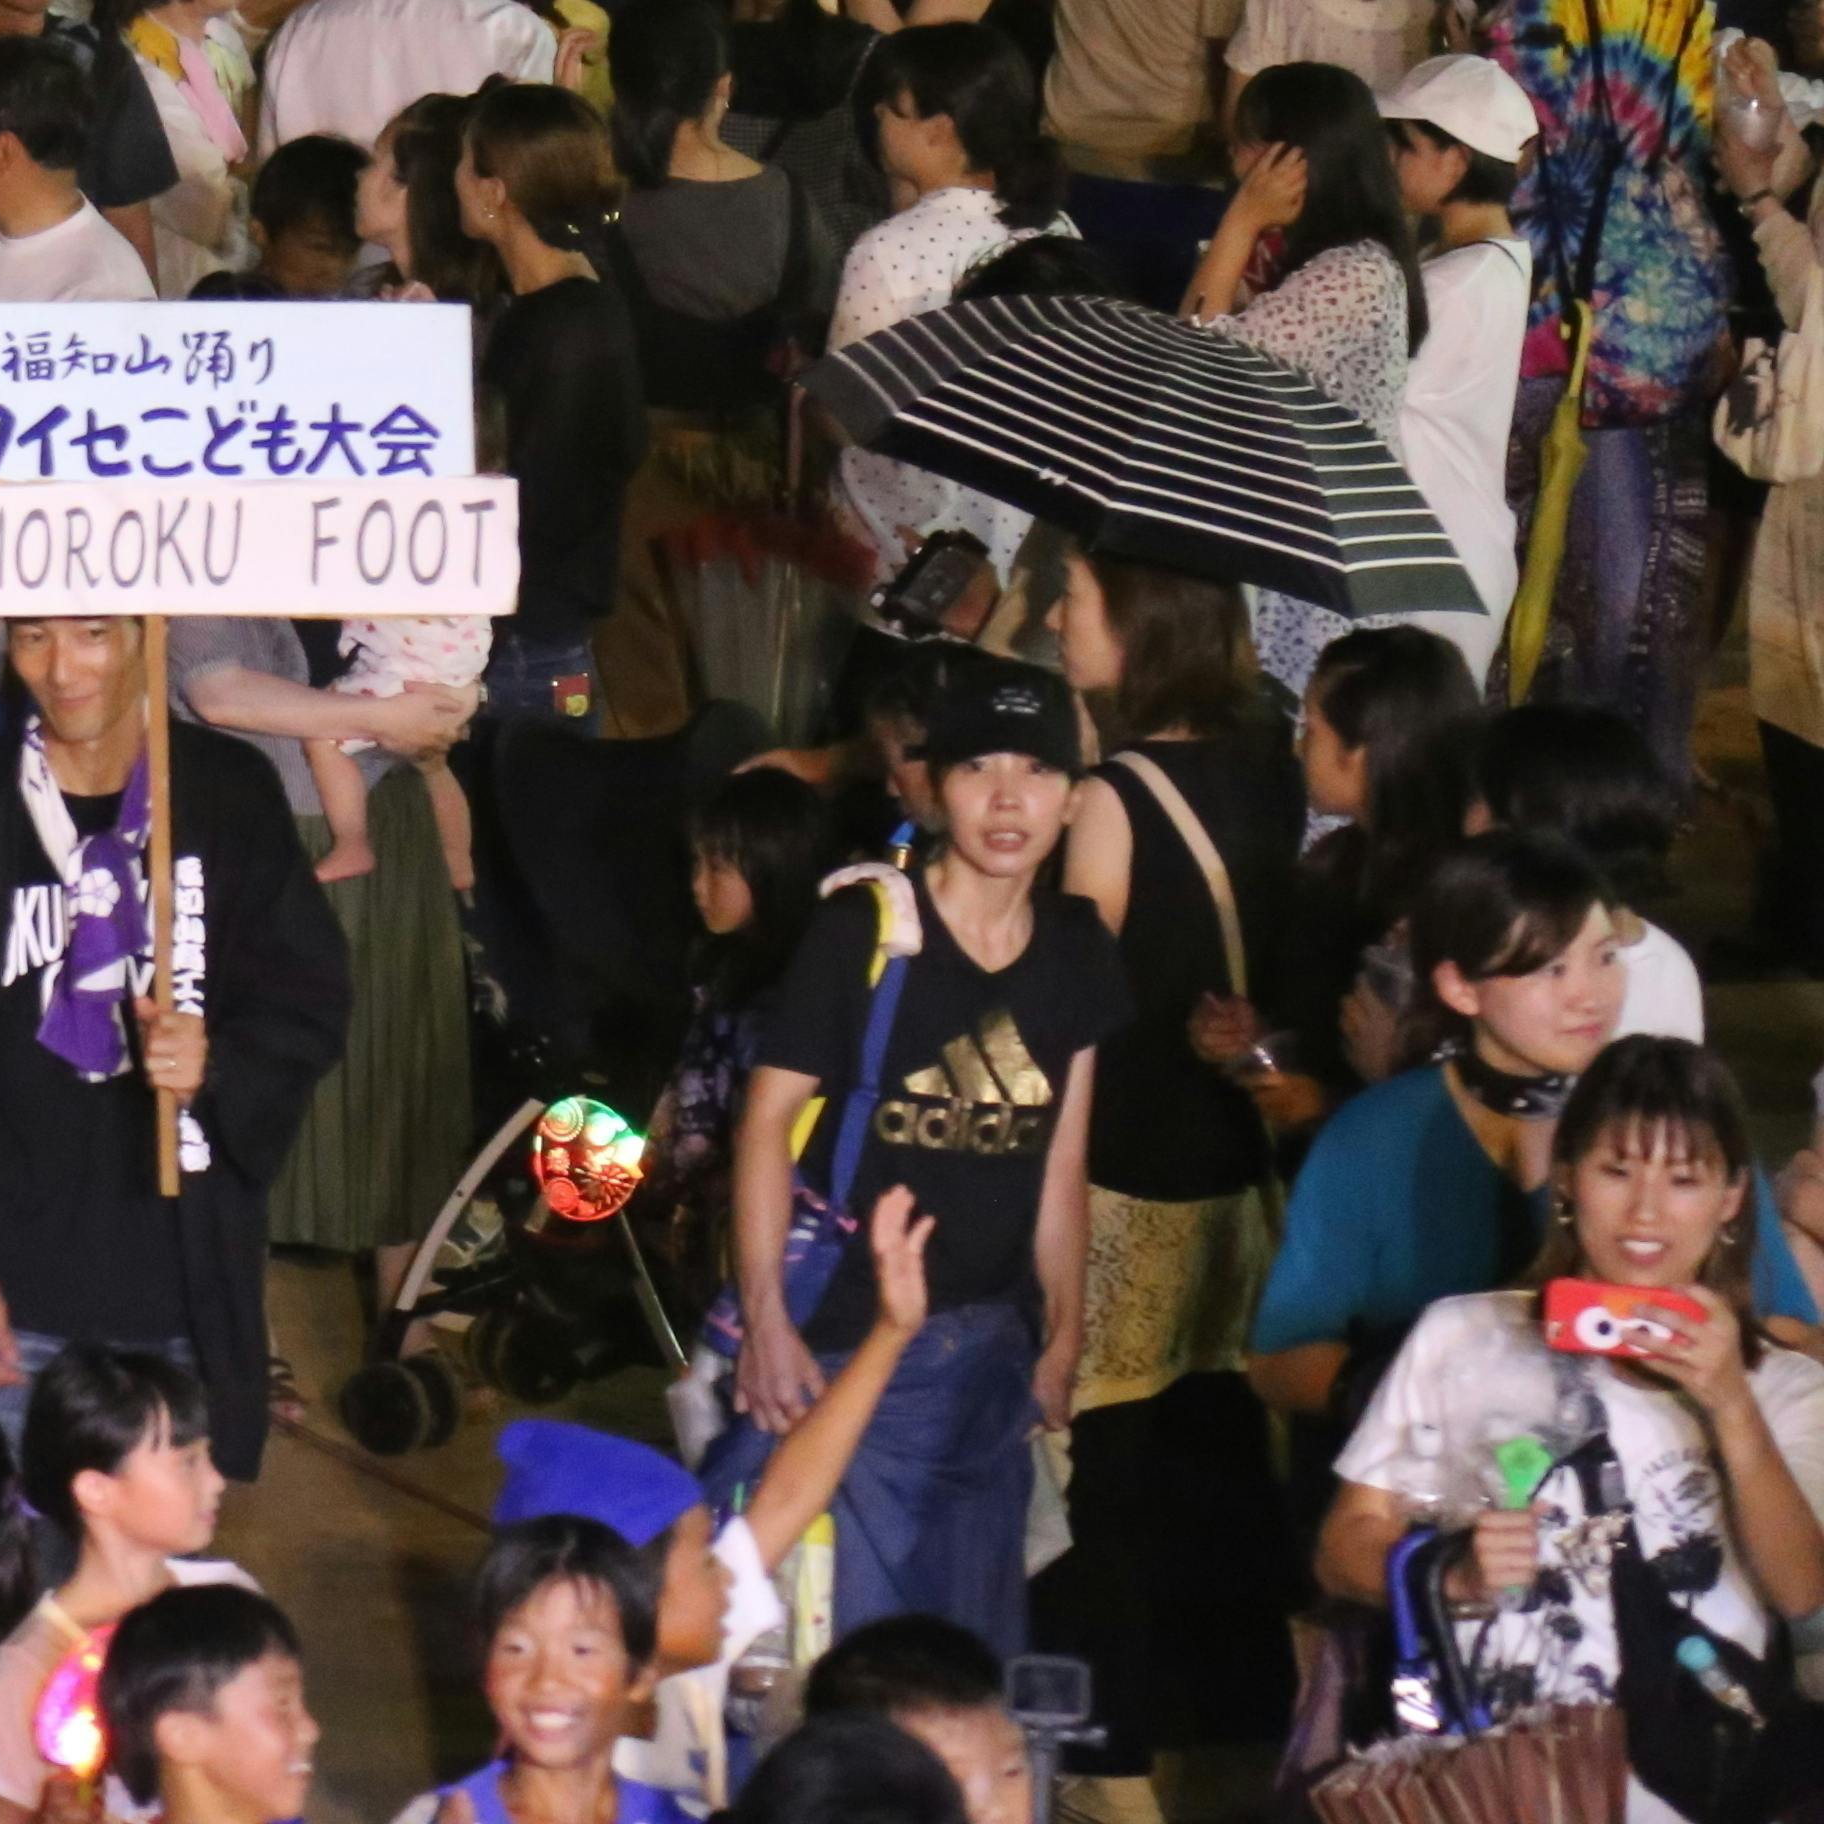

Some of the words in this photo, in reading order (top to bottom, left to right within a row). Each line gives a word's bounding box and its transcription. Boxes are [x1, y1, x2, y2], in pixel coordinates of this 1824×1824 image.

[1, 329, 277, 385] 福知山踊り
[309, 497, 497, 589] FOOT
